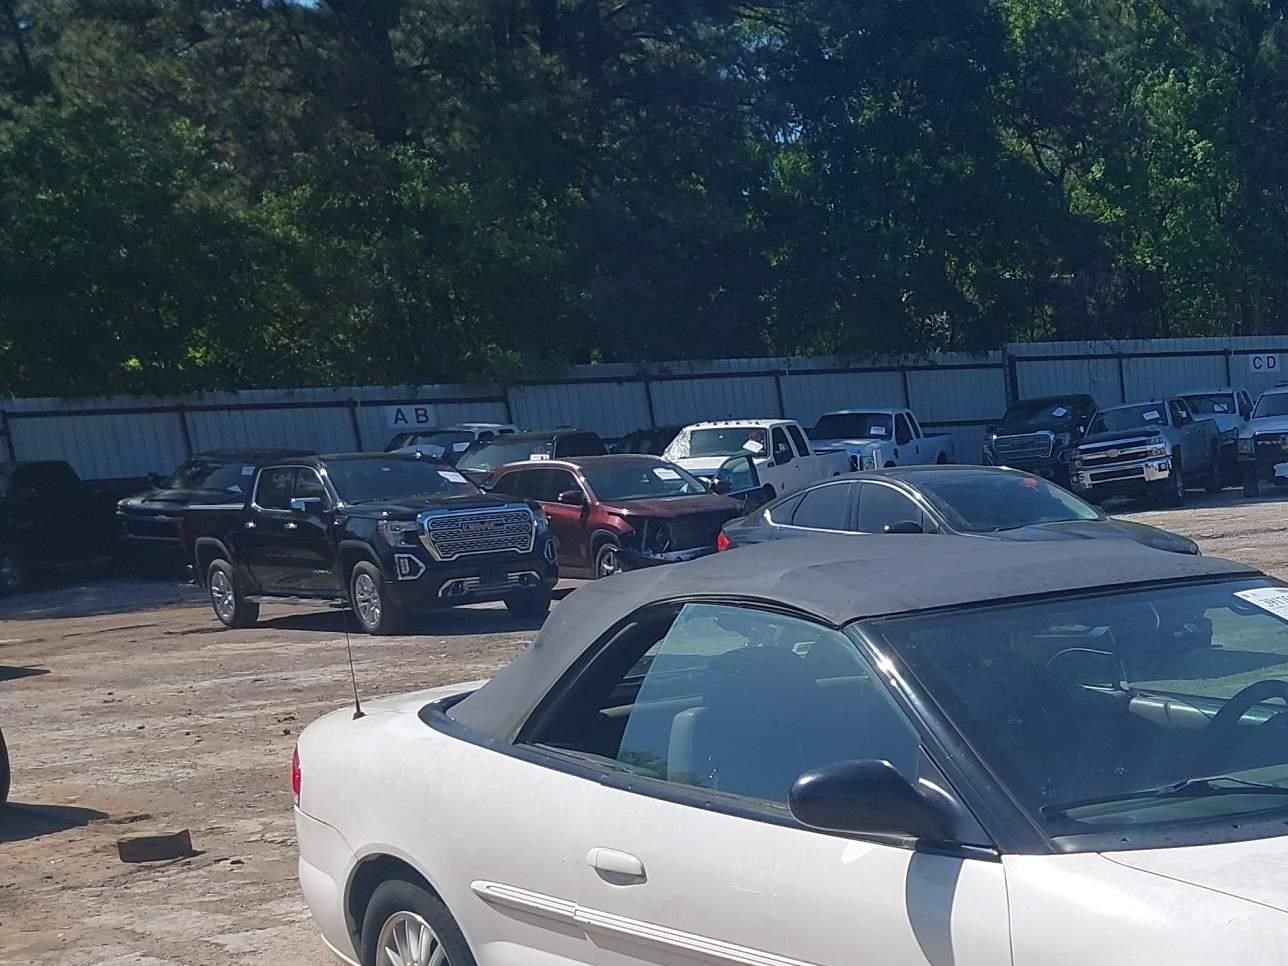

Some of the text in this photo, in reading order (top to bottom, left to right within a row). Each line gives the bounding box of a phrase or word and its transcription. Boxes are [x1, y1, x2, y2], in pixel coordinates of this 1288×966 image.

[1253, 356, 1277, 370] C D
[394, 407, 430, 425] A B
